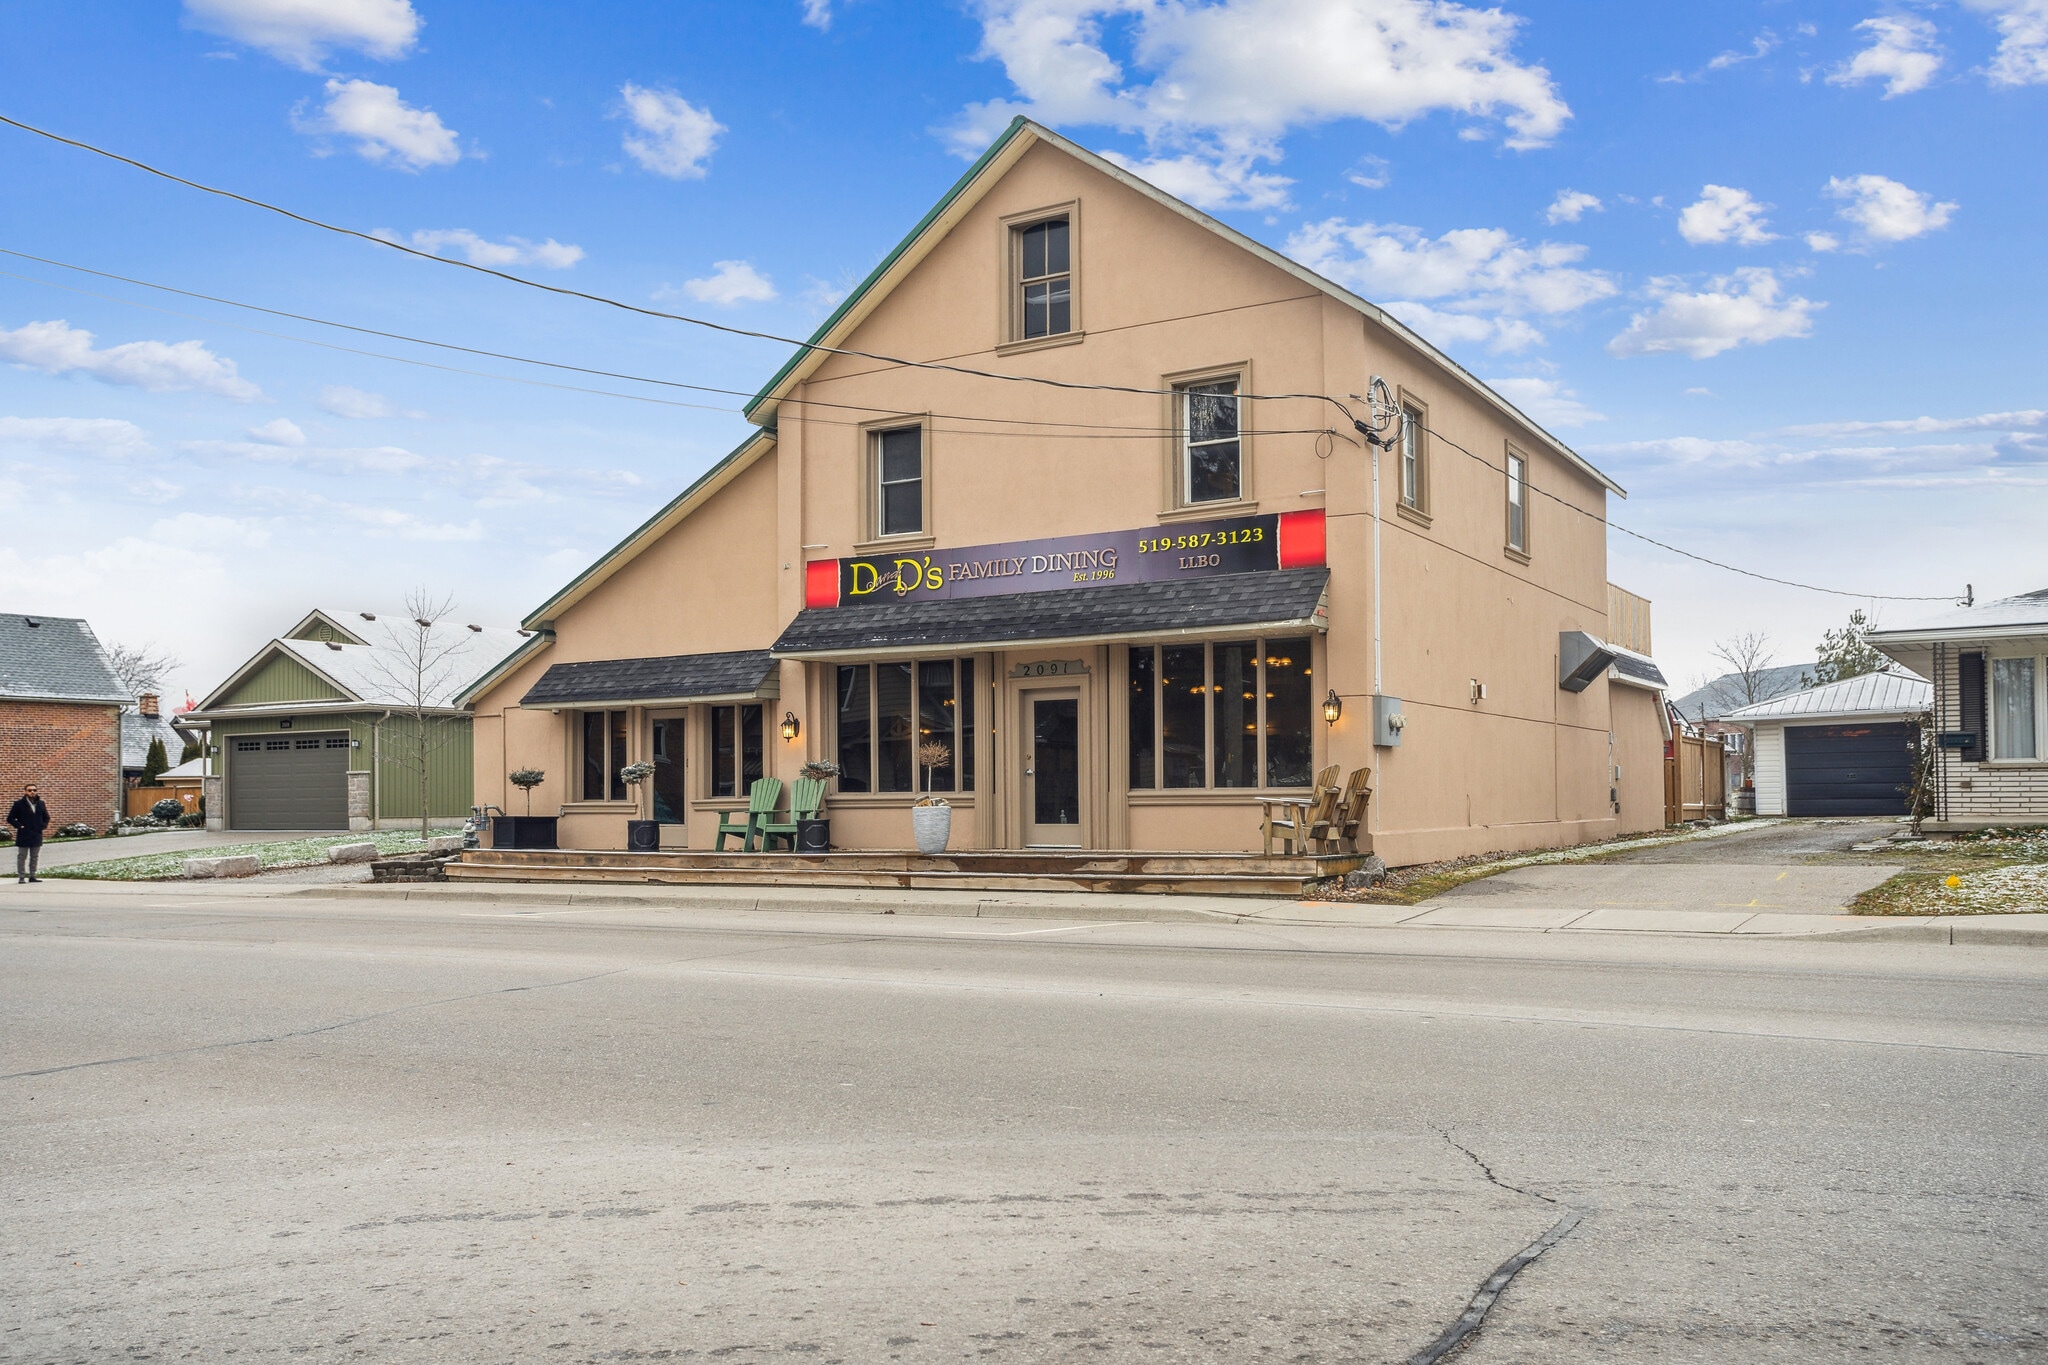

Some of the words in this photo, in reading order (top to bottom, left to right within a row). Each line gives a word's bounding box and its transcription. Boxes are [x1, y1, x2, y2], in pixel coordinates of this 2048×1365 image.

[1138, 527, 1264, 554] 519-587-3123
[1178, 553, 1221, 570] LLBO
[849, 562, 879, 595] D
[893, 556, 944, 593] D's
[948, 556, 1028, 581] FAMILY
[1031, 548, 1119, 574] DINING
[1072, 571, 1090, 583] Est.
[1090, 568, 1116, 581] 1996
[1023, 662, 1068, 676] 2091
